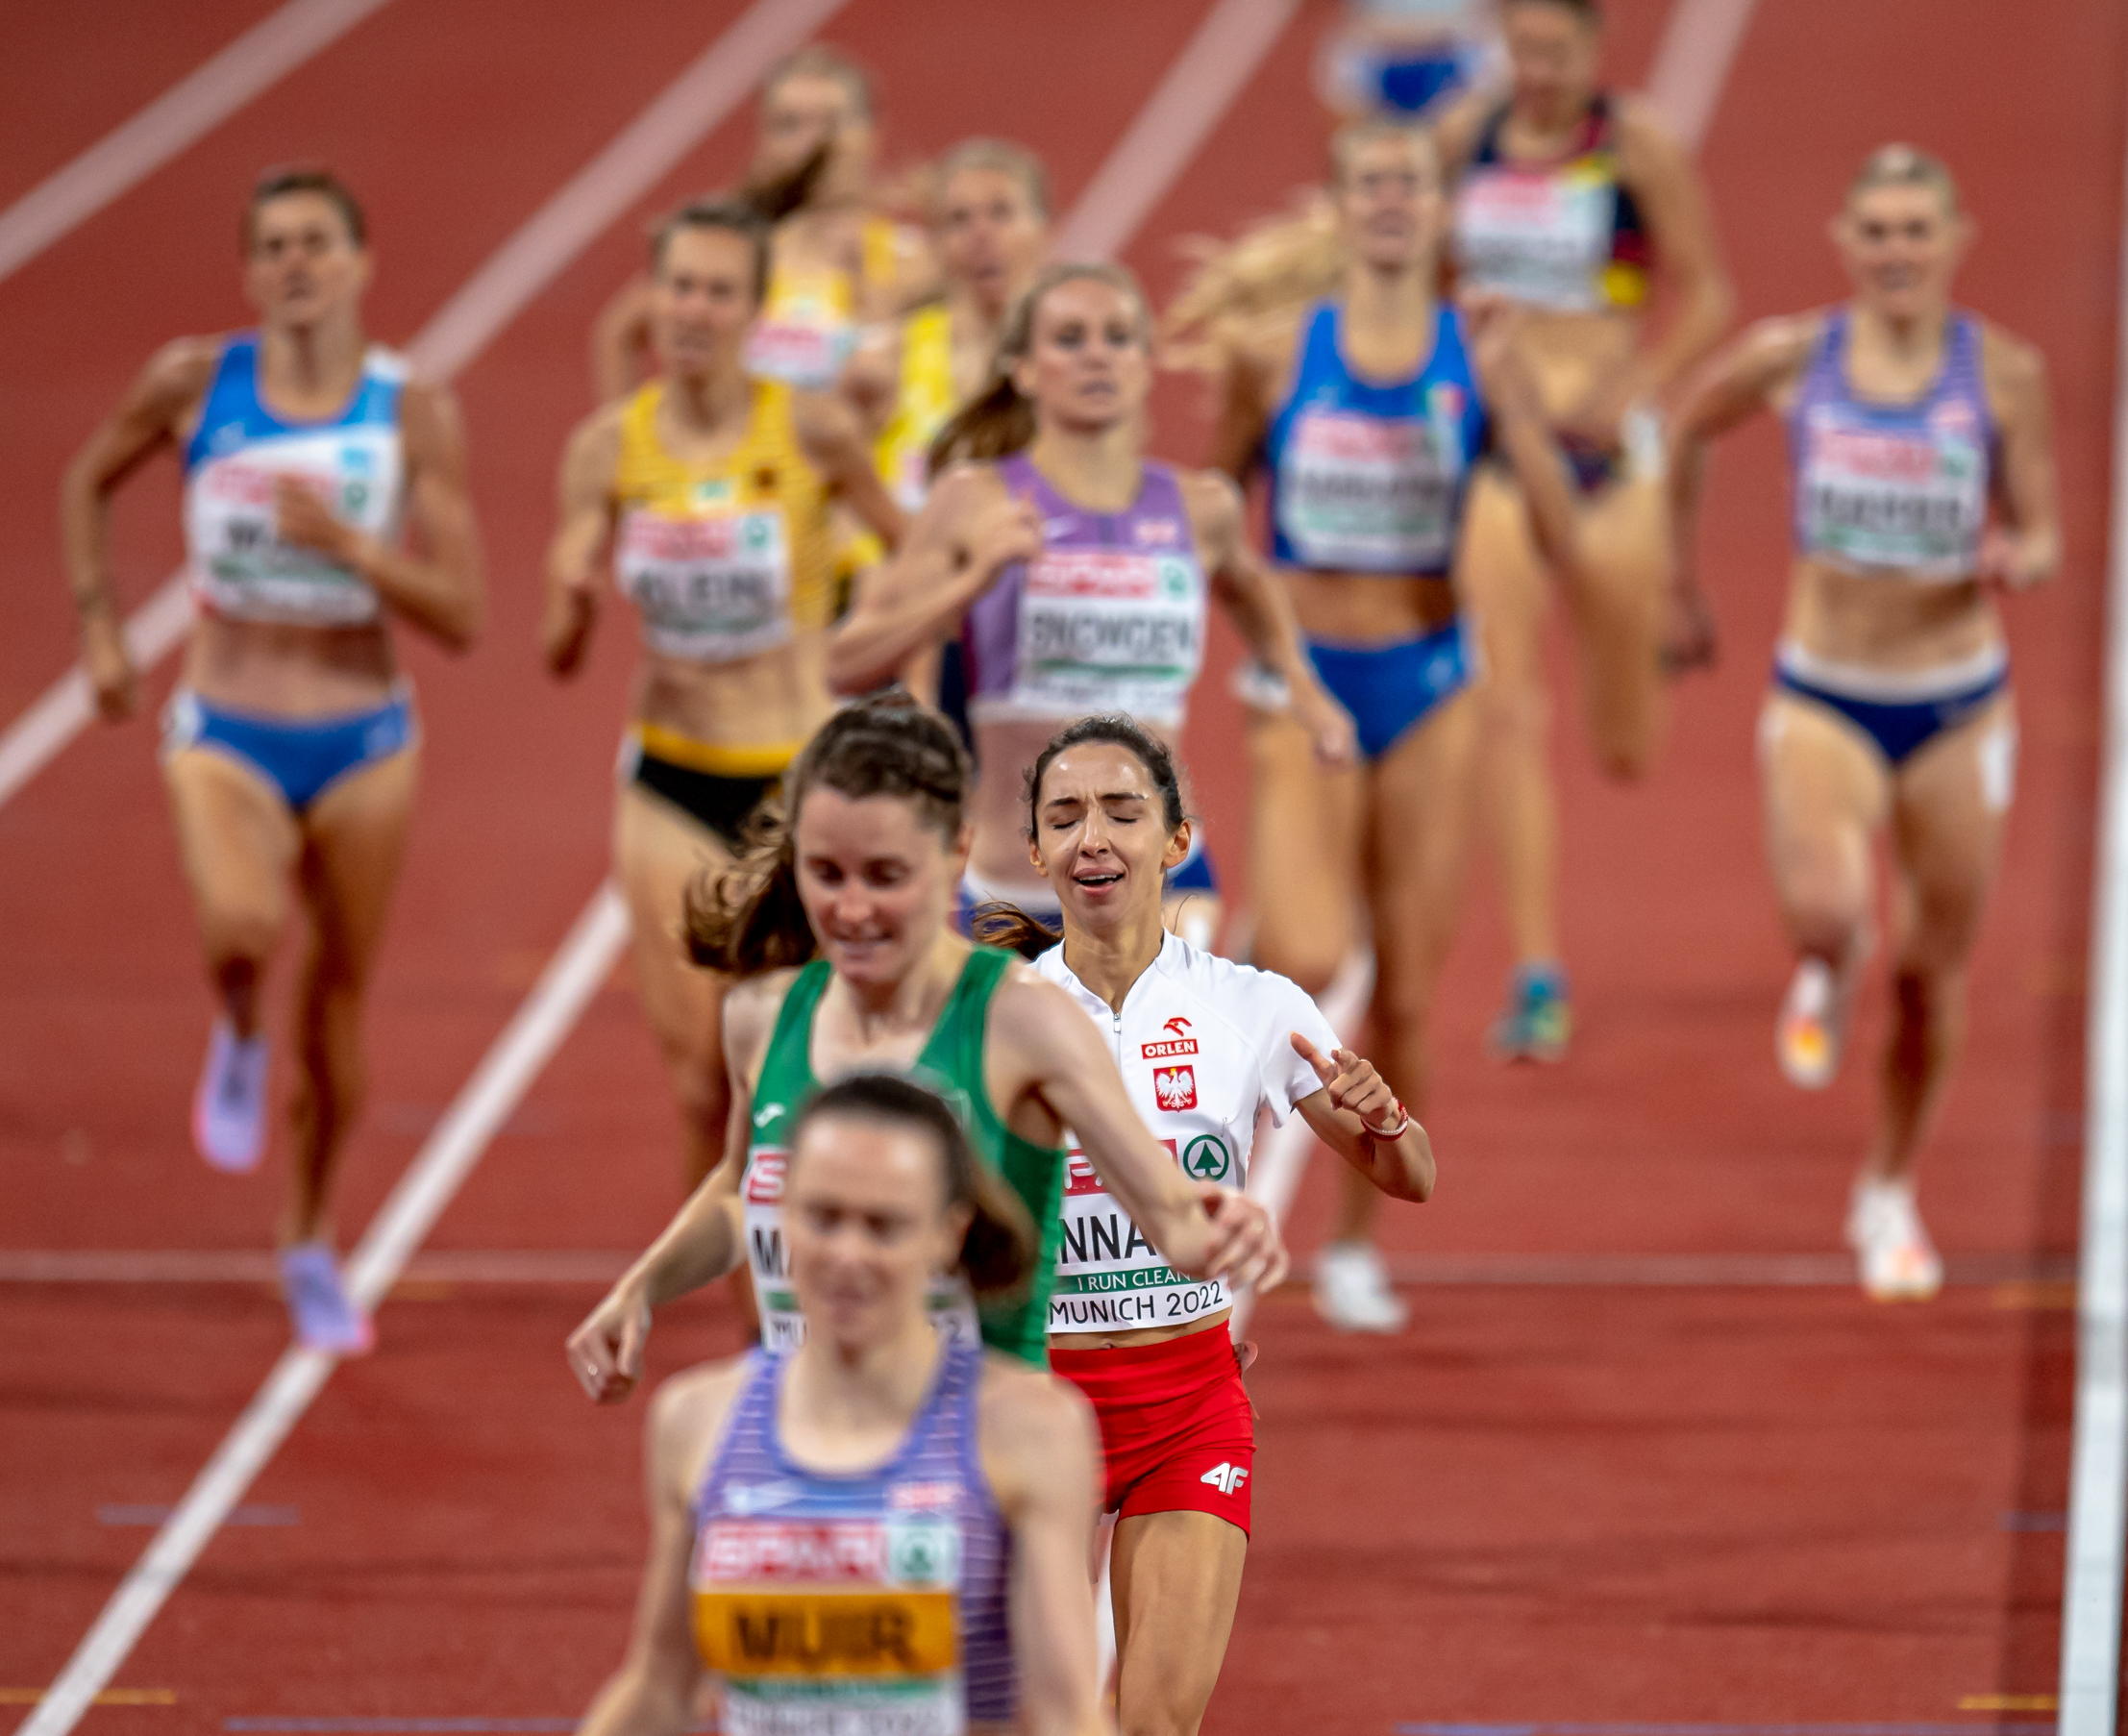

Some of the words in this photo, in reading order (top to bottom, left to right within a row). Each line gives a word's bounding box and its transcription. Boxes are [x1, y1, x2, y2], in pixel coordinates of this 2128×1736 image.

[1145, 1041, 1195, 1057] ORLEN
[1077, 1277, 1083, 1291] I
[1088, 1275, 1126, 1291] RUN
[1132, 1269, 1191, 1287] CLEAN
[1050, 1295, 1155, 1326] MUNICH
[1166, 1280, 1224, 1317] 2022
[1200, 1461, 1249, 1495] 4F
